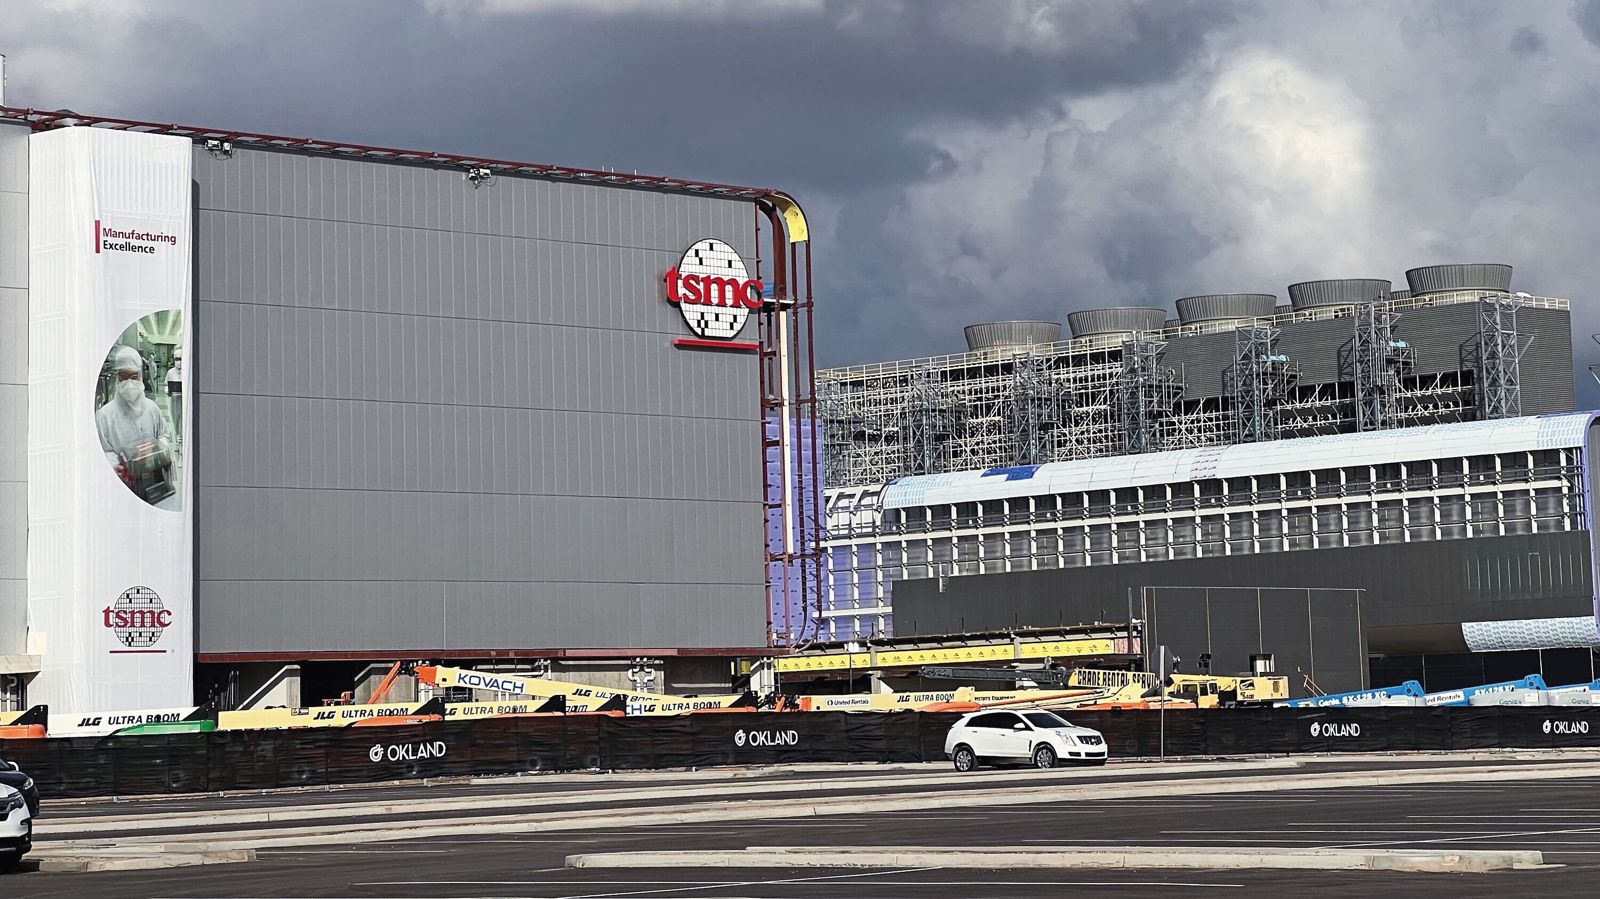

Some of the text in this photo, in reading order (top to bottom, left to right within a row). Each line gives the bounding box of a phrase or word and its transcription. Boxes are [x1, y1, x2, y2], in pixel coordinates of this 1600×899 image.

[103, 227, 177, 245] Manufacturing
[103, 240, 155, 254] Excellence
[664, 265, 764, 309] tsmc
[102, 606, 172, 628] tsmc
[458, 673, 525, 693] KOVACH
[572, 688, 593, 697] JLG
[897, 693, 955, 703] JLG ULTRA BOOM
[661, 703, 692, 712] ULTRA
[693, 701, 721, 710] BOOM
[834, 698, 869, 706] United Rentals
[313, 711, 336, 720] JLG
[341, 709, 374, 719] ULTRA
[377, 707, 409, 717] BOOM
[463, 706, 493, 715] ULTRA
[497, 705, 528, 714] BOOM
[78, 713, 180, 727] JLG ULTRA BOOM
[1322, 723, 1361, 737] OKLAND
[1553, 721, 1589, 734] OKLAND
[749, 730, 798, 746] OKLAND
[387, 741, 446, 761] OKLAND
